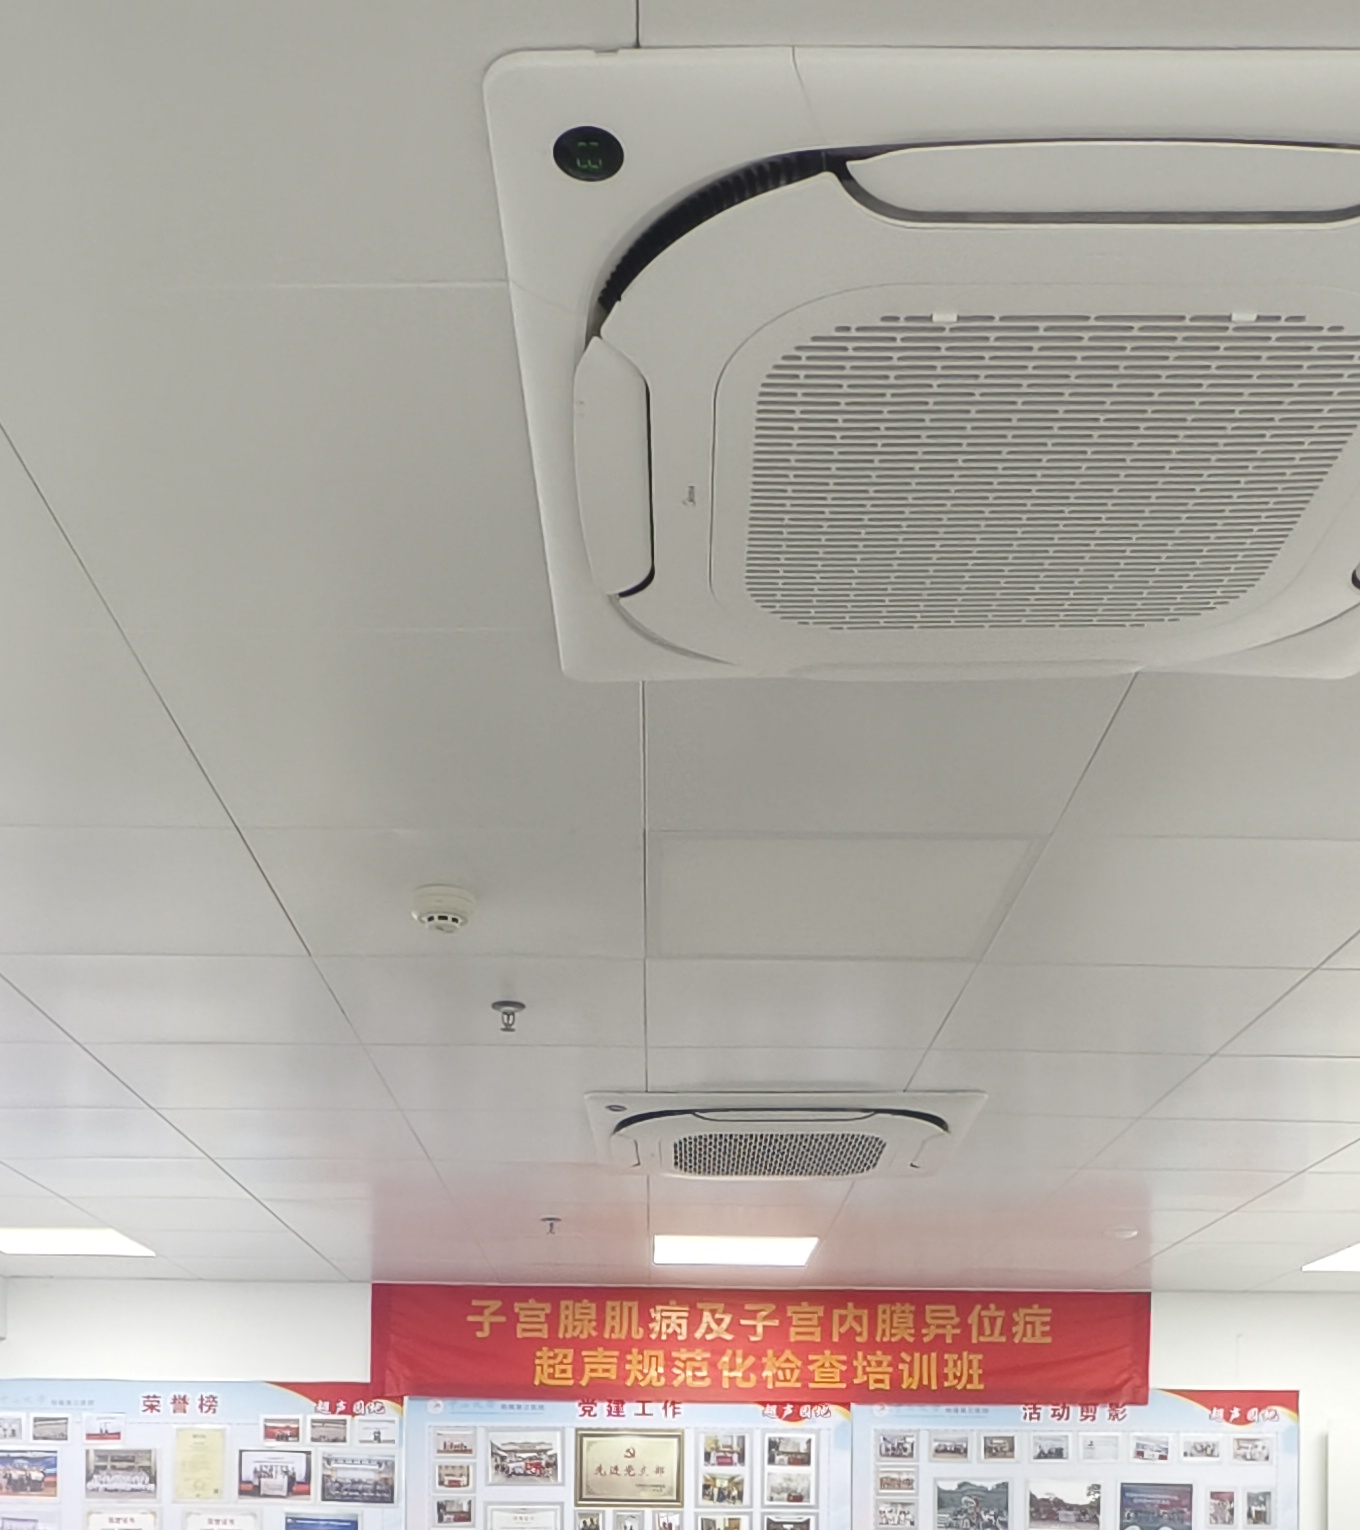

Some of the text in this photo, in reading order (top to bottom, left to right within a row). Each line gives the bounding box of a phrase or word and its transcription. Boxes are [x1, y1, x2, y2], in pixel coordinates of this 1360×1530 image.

[466, 1299, 1053, 1344] 子宫腺肌病及子宫内膜异位症
[533, 1347, 985, 1390] 超声规范化检查培训班
[141, 1394, 218, 1414] 荣誉榜
[578, 1399, 682, 1419] 党建工作
[1022, 1402, 1127, 1421] 活动剪影
